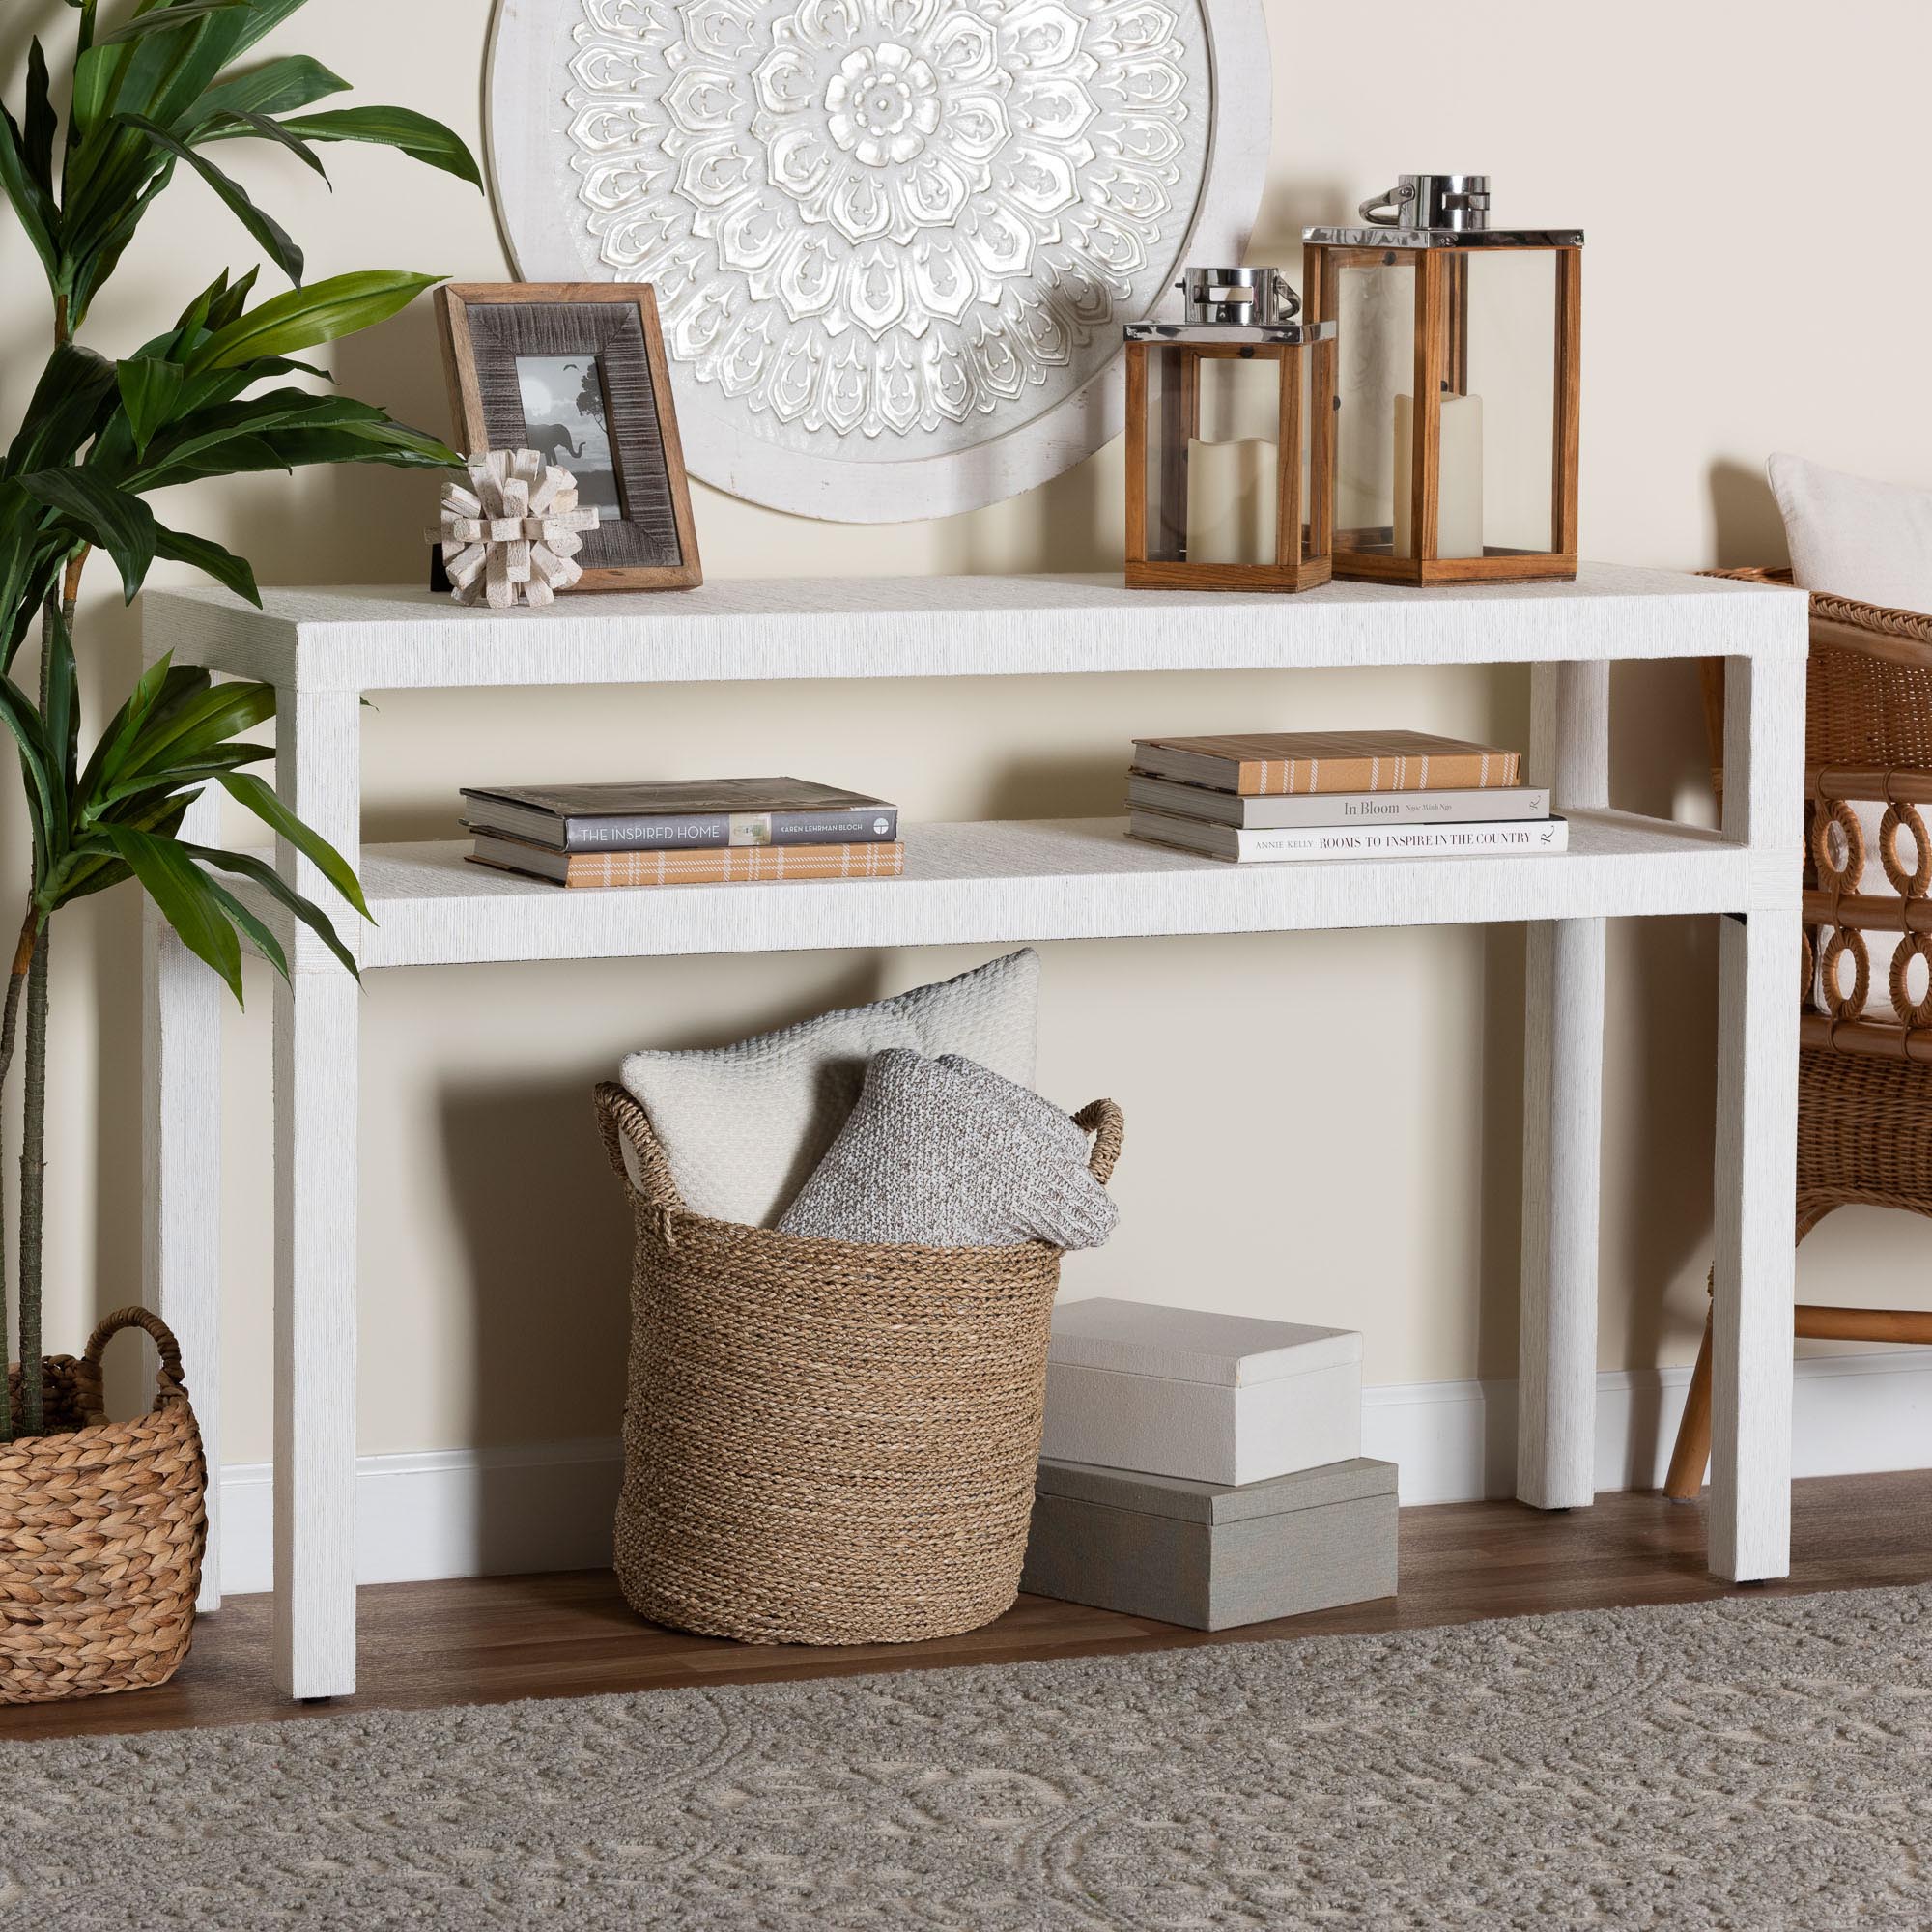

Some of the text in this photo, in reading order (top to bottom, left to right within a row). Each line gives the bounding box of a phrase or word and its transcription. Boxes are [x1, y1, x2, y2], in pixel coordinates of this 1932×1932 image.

[1344, 801, 1399, 815] In Bloom
[580, 825, 720, 841] THE INSPIRED HOME
[805, 824, 837, 833] LEHRMAN
[838, 823, 863, 832] BLOCH
[1287, 839, 1314, 848] KELLY
[1320, 832, 1531, 849] ROOMS TO INSPIRE IN THE COUNTRY
